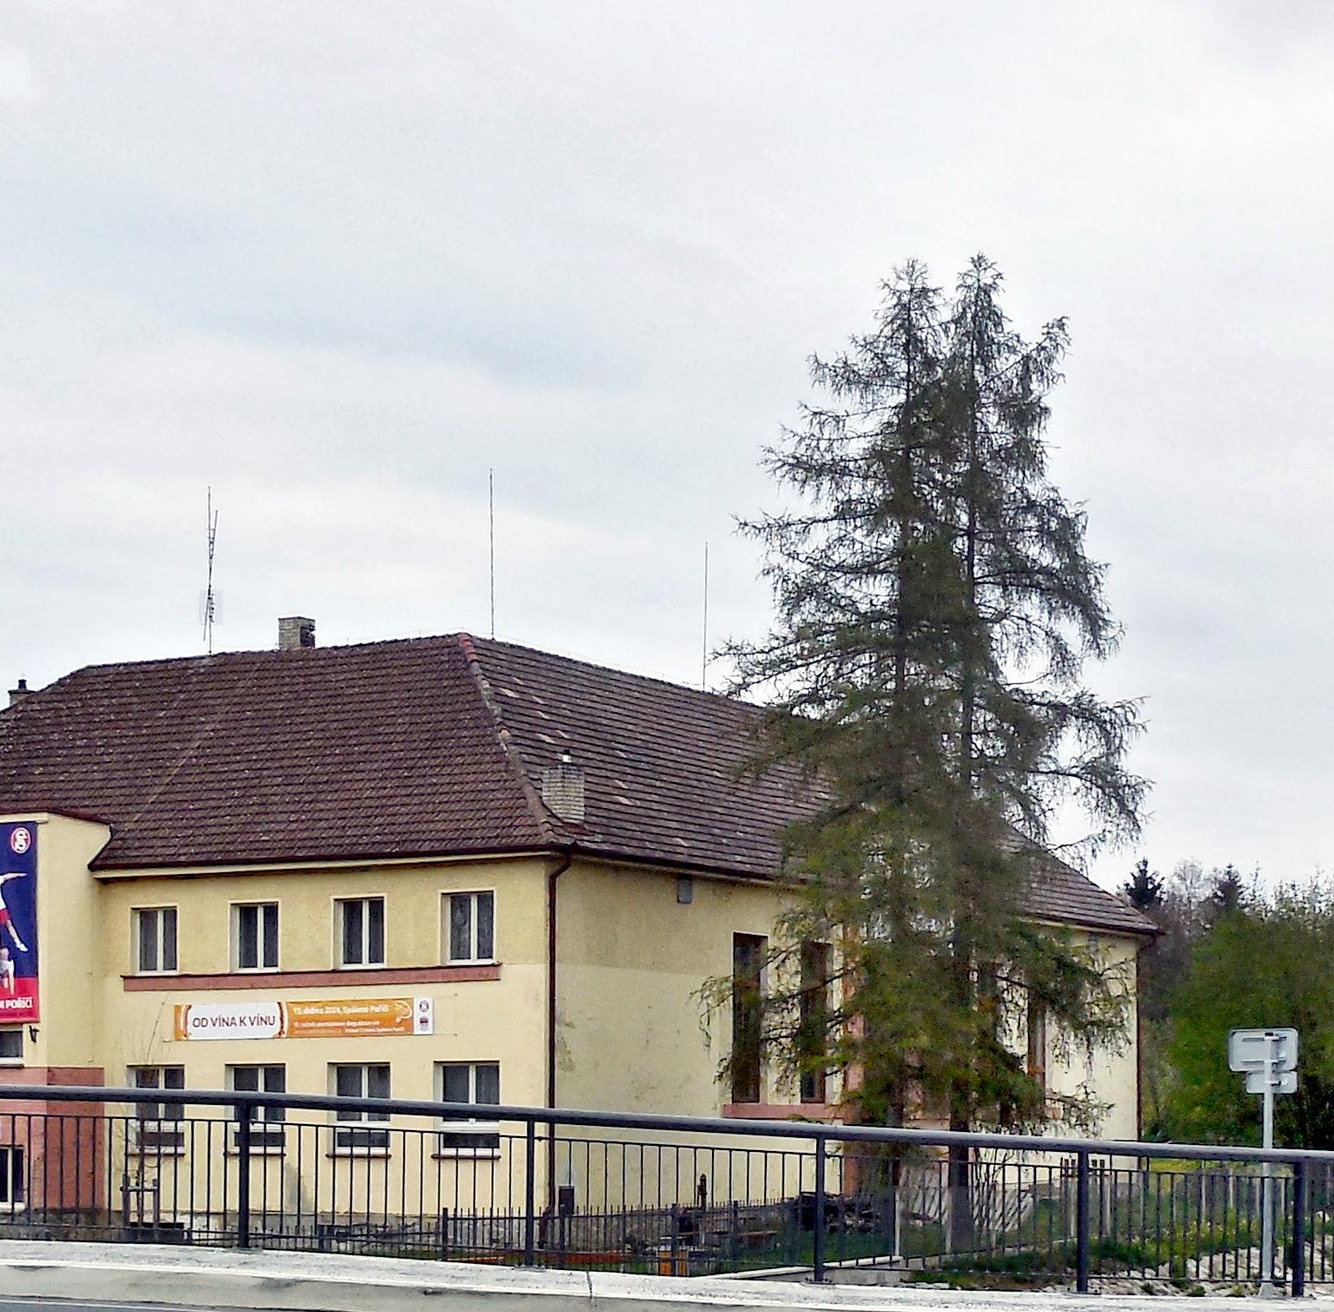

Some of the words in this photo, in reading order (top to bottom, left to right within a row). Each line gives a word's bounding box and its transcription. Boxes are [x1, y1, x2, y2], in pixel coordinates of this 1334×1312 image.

[192, 1017, 209, 1028] OD
[210, 1014, 237, 1027] VÍNA
[239, 1016, 247, 1027] K
[249, 1013, 276, 1026] VÍNU
